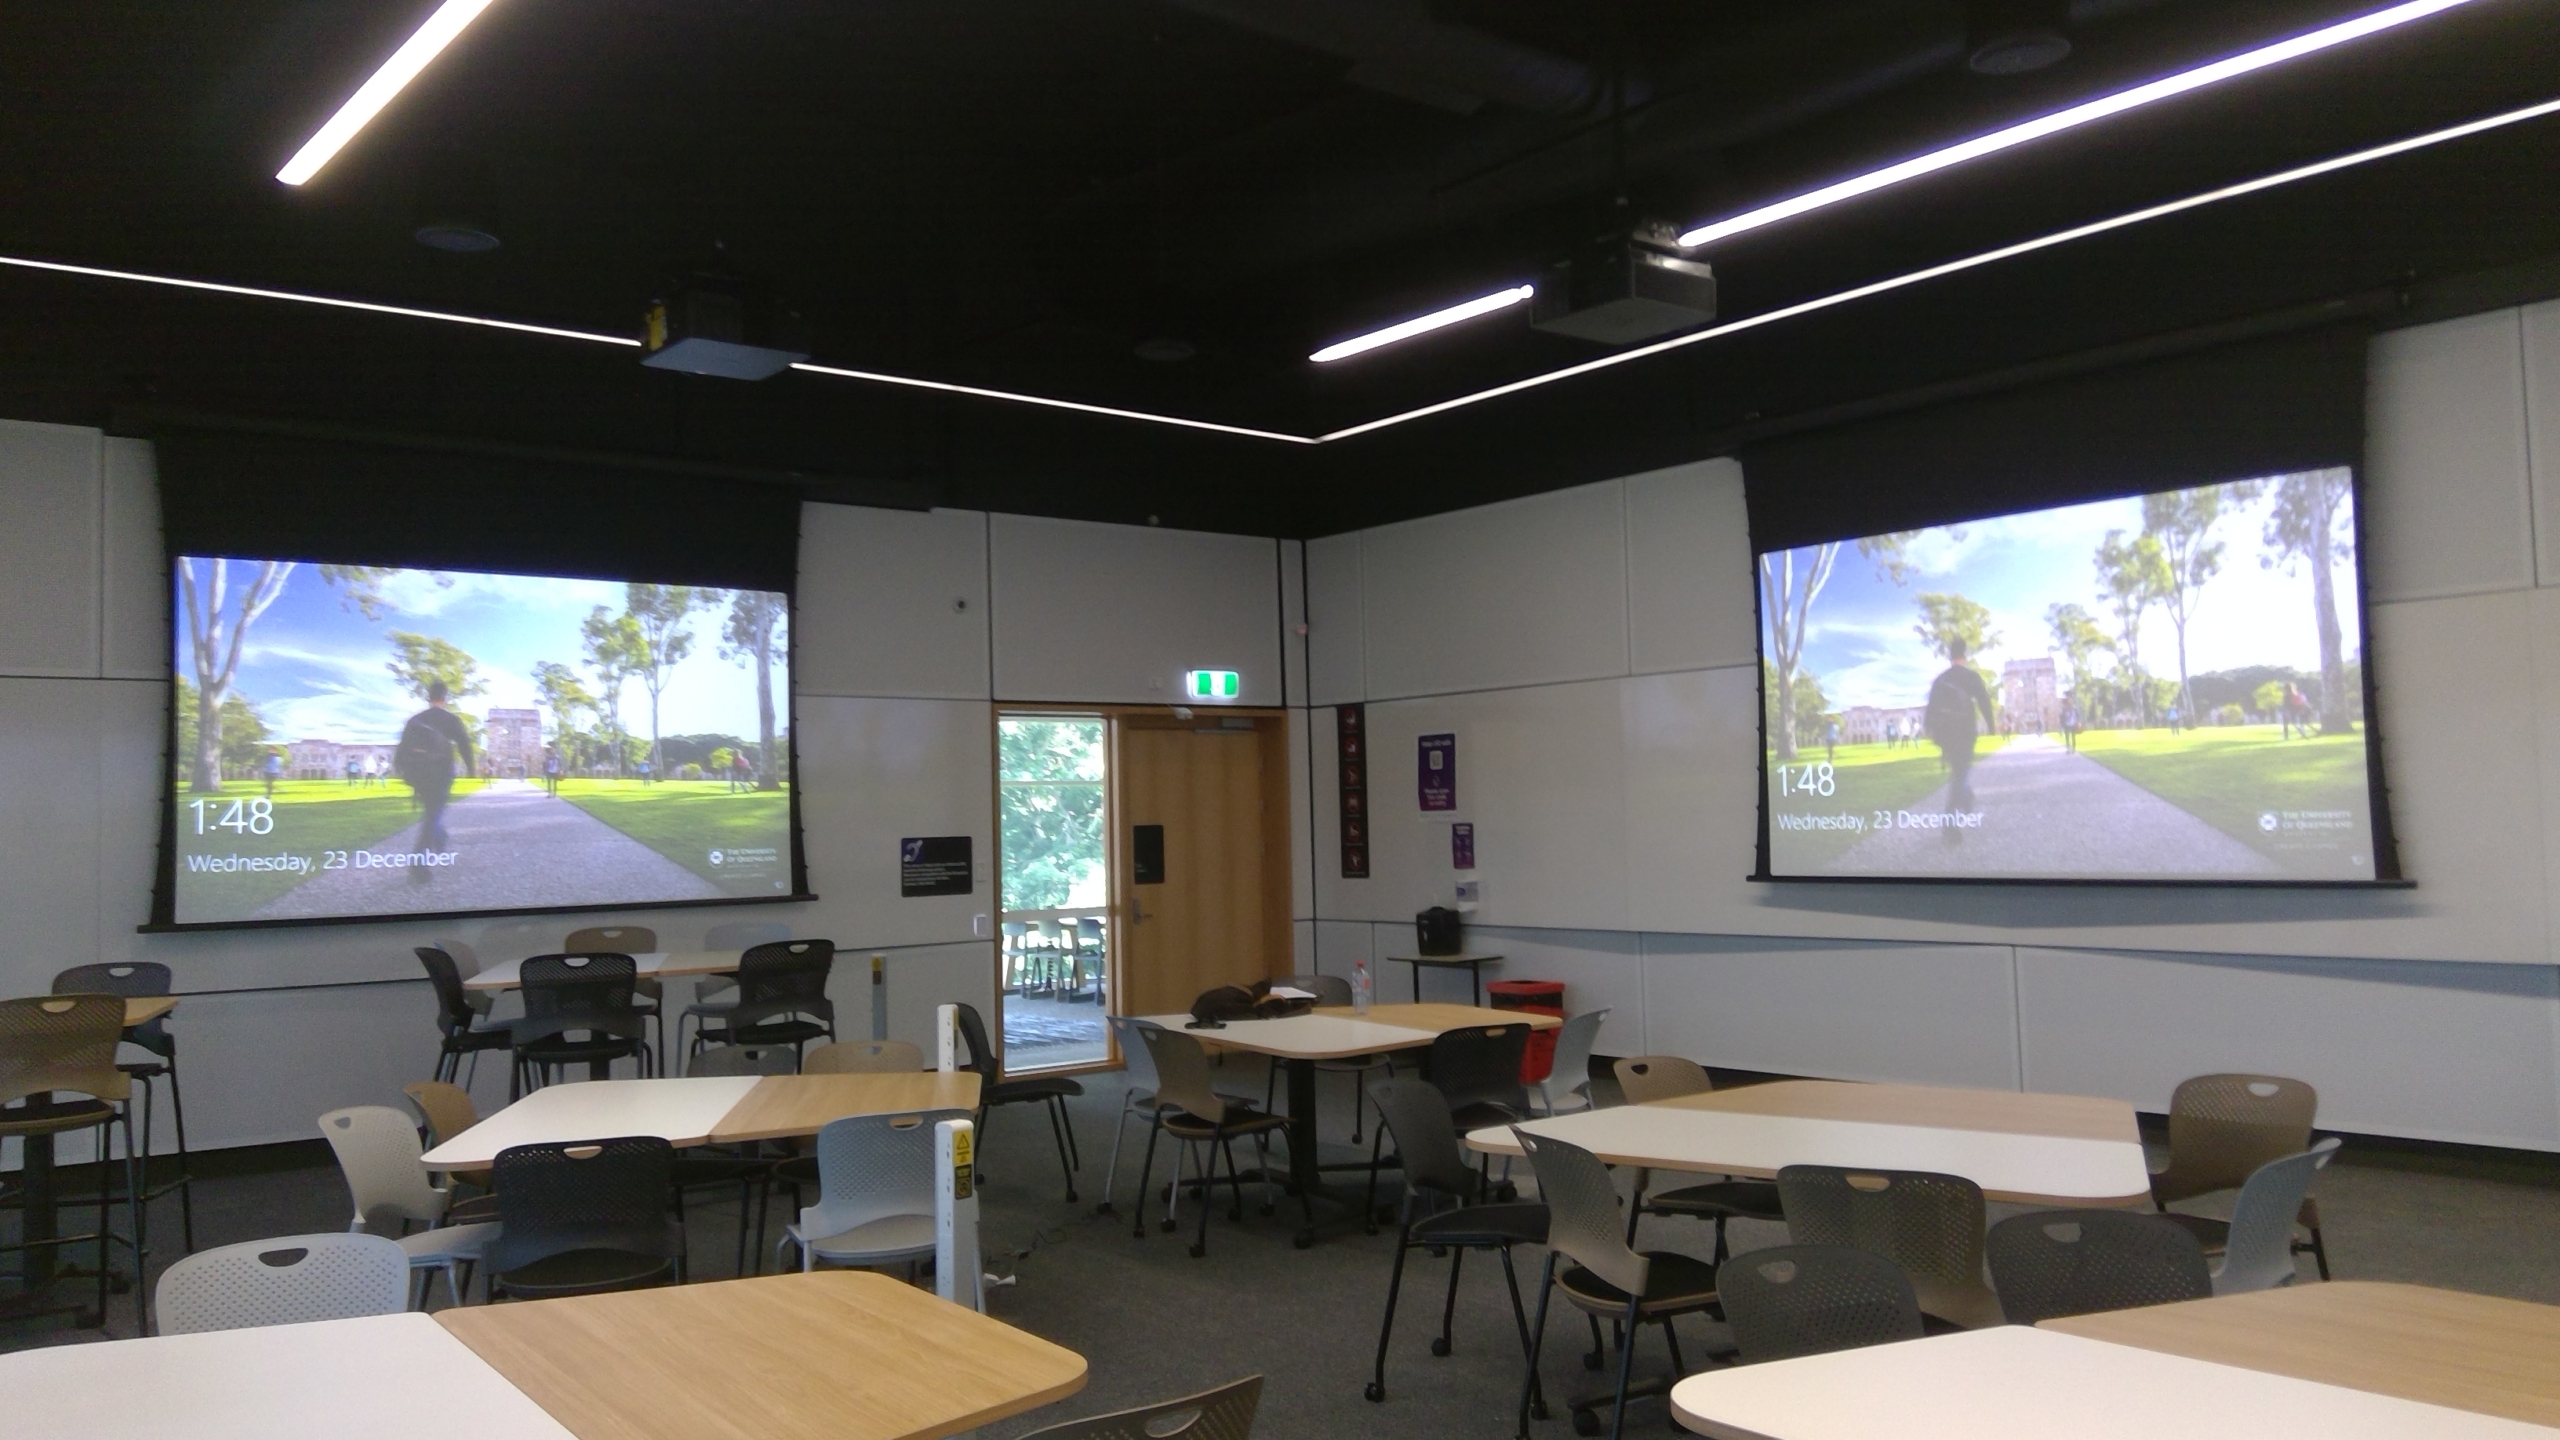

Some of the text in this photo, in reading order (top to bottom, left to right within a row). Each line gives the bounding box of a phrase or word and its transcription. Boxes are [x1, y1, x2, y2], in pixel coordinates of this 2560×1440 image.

[1777, 762, 1835, 797] 1:48
[189, 798, 274, 835] 1:48
[1777, 809, 1983, 834] Wednesday, 23 December
[188, 849, 459, 875] Wednesday, 23 December
